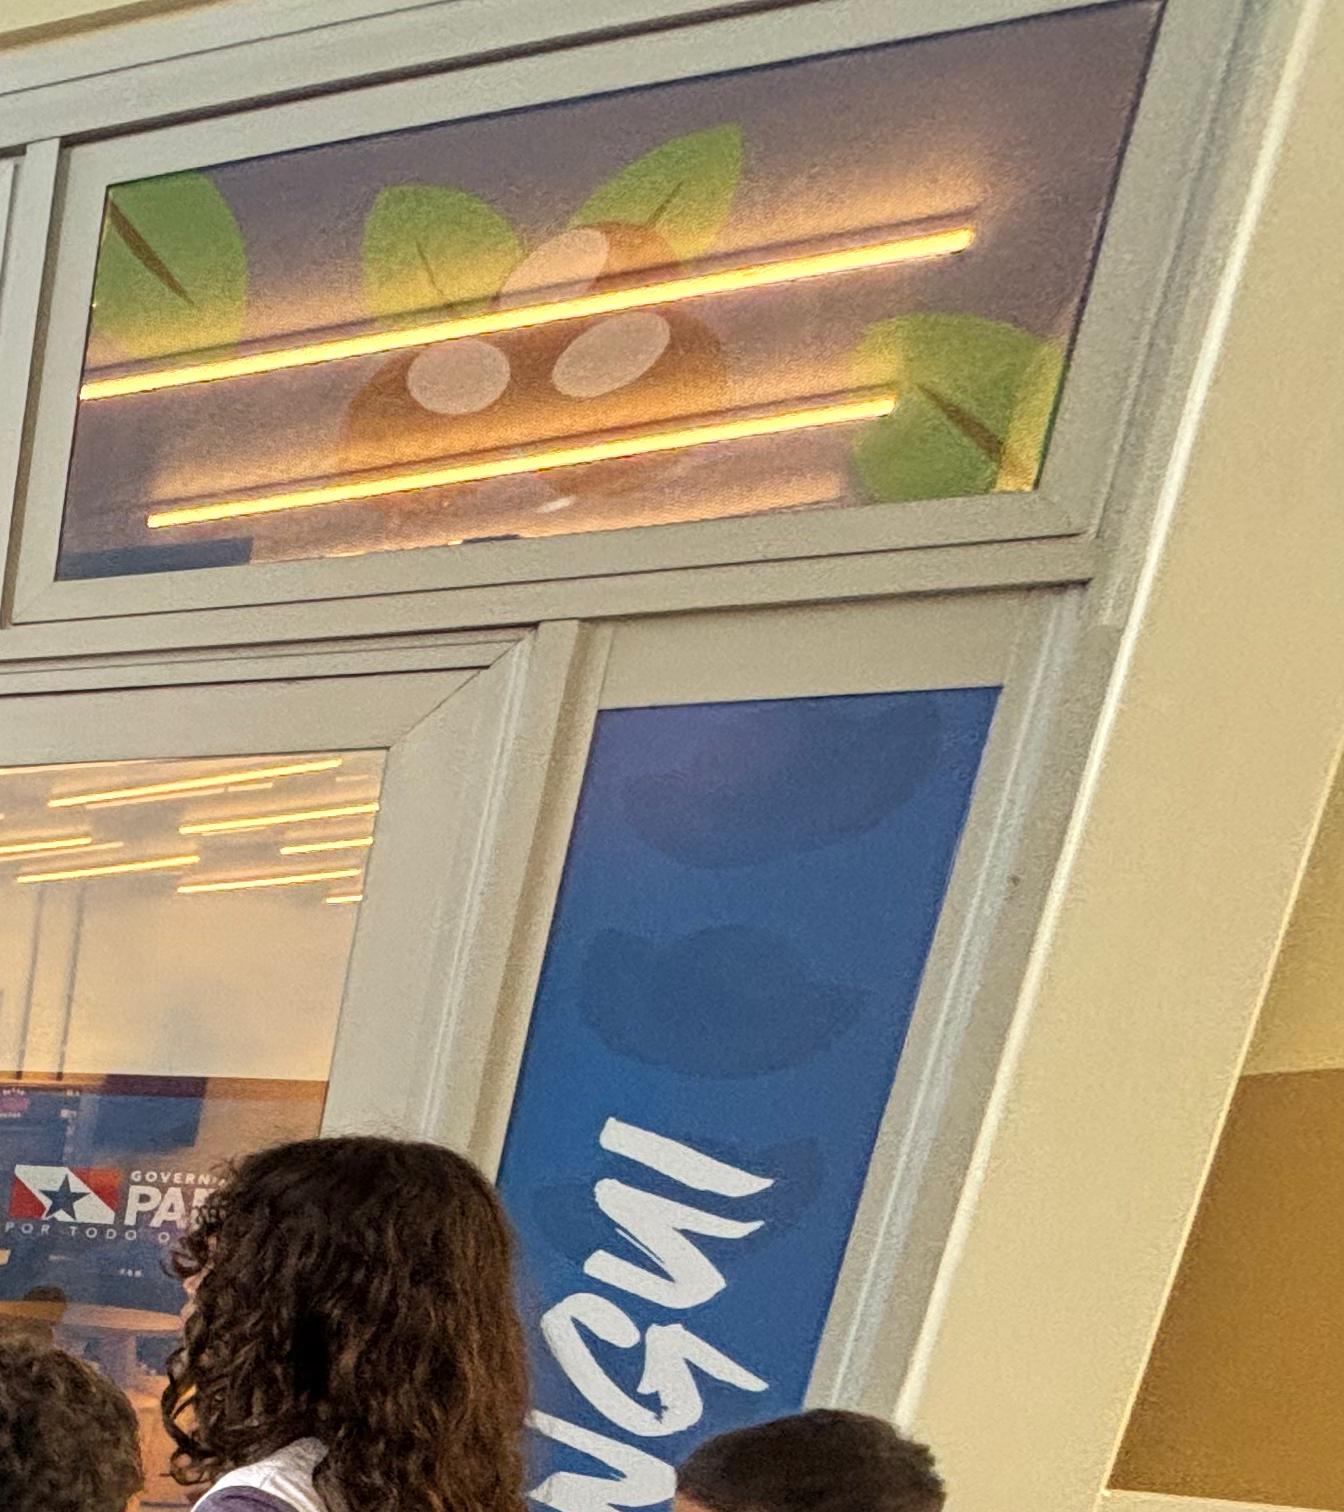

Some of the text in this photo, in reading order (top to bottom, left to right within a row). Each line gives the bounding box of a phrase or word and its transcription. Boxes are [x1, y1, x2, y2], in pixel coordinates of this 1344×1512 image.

[131, 1170, 226, 1186] GOVERN
[124, 1185, 217, 1231] PA
[5, 1222, 49, 1235] POR
[69, 1226, 137, 1241] TODO
